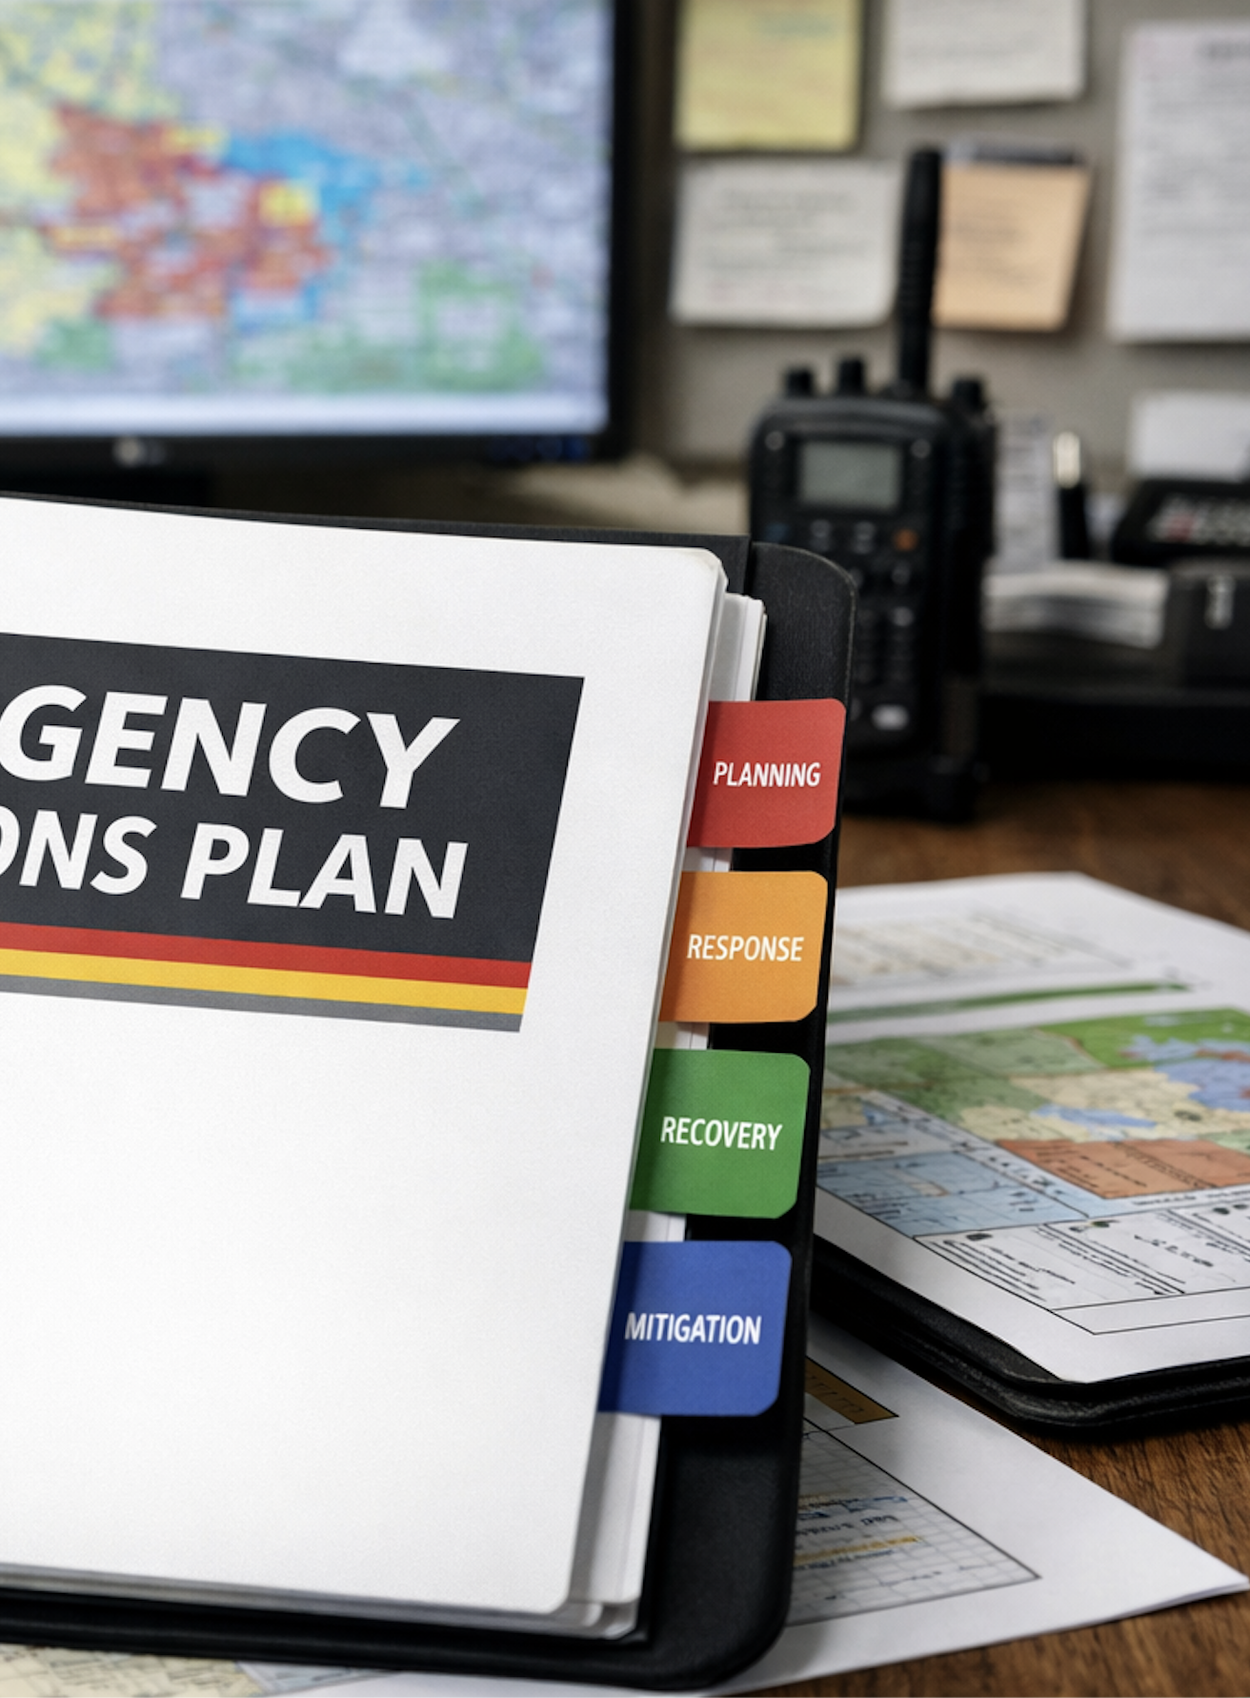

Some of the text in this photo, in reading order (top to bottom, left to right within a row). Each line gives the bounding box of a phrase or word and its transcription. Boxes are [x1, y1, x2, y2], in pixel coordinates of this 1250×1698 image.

[712, 760, 822, 788] PLANNING
[180, 822, 468, 919] PLAN
[686, 933, 805, 963] RESPONSE
[660, 1115, 784, 1152] RECOVERY
[626, 1312, 763, 1346] MITIGATION
